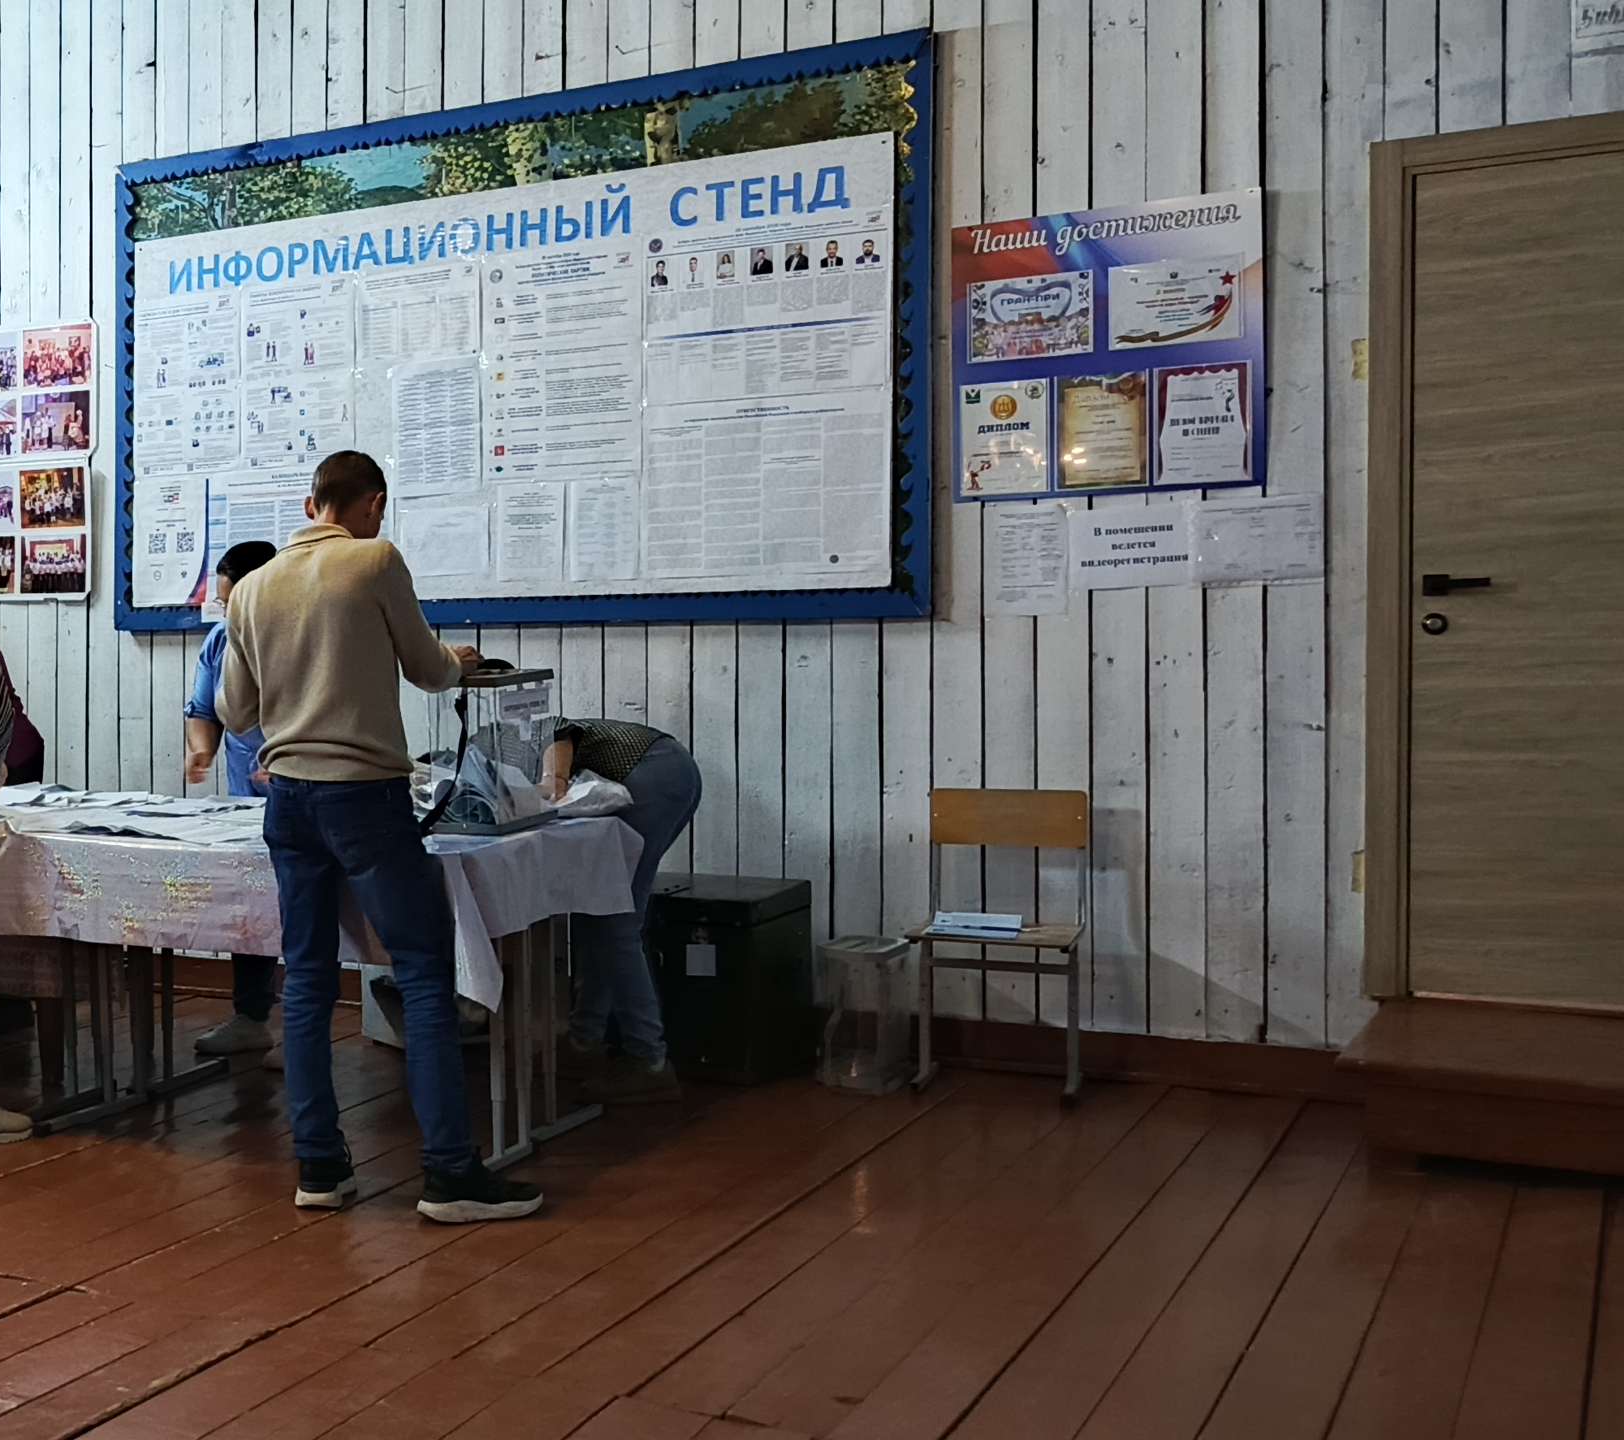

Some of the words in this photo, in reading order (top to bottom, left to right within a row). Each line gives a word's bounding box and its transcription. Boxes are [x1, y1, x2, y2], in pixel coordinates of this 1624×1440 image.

[167, 186, 633, 297] ИНФОРМАЦИОННЫЙ
[669, 163, 851, 228] СТЕНД
[970, 226, 1048, 255] Наши
[1054, 203, 1241, 256] достижения
[1000, 293, 1061, 306] ГРАН-ПРИ
[977, 421, 1031, 435] ДИПЛОМ
[1093, 527, 1103, 537] В
[1105, 524, 1174, 536] помещении
[1111, 540, 1157, 551] ведется
[1080, 553, 1189, 568] видеорегистрация
